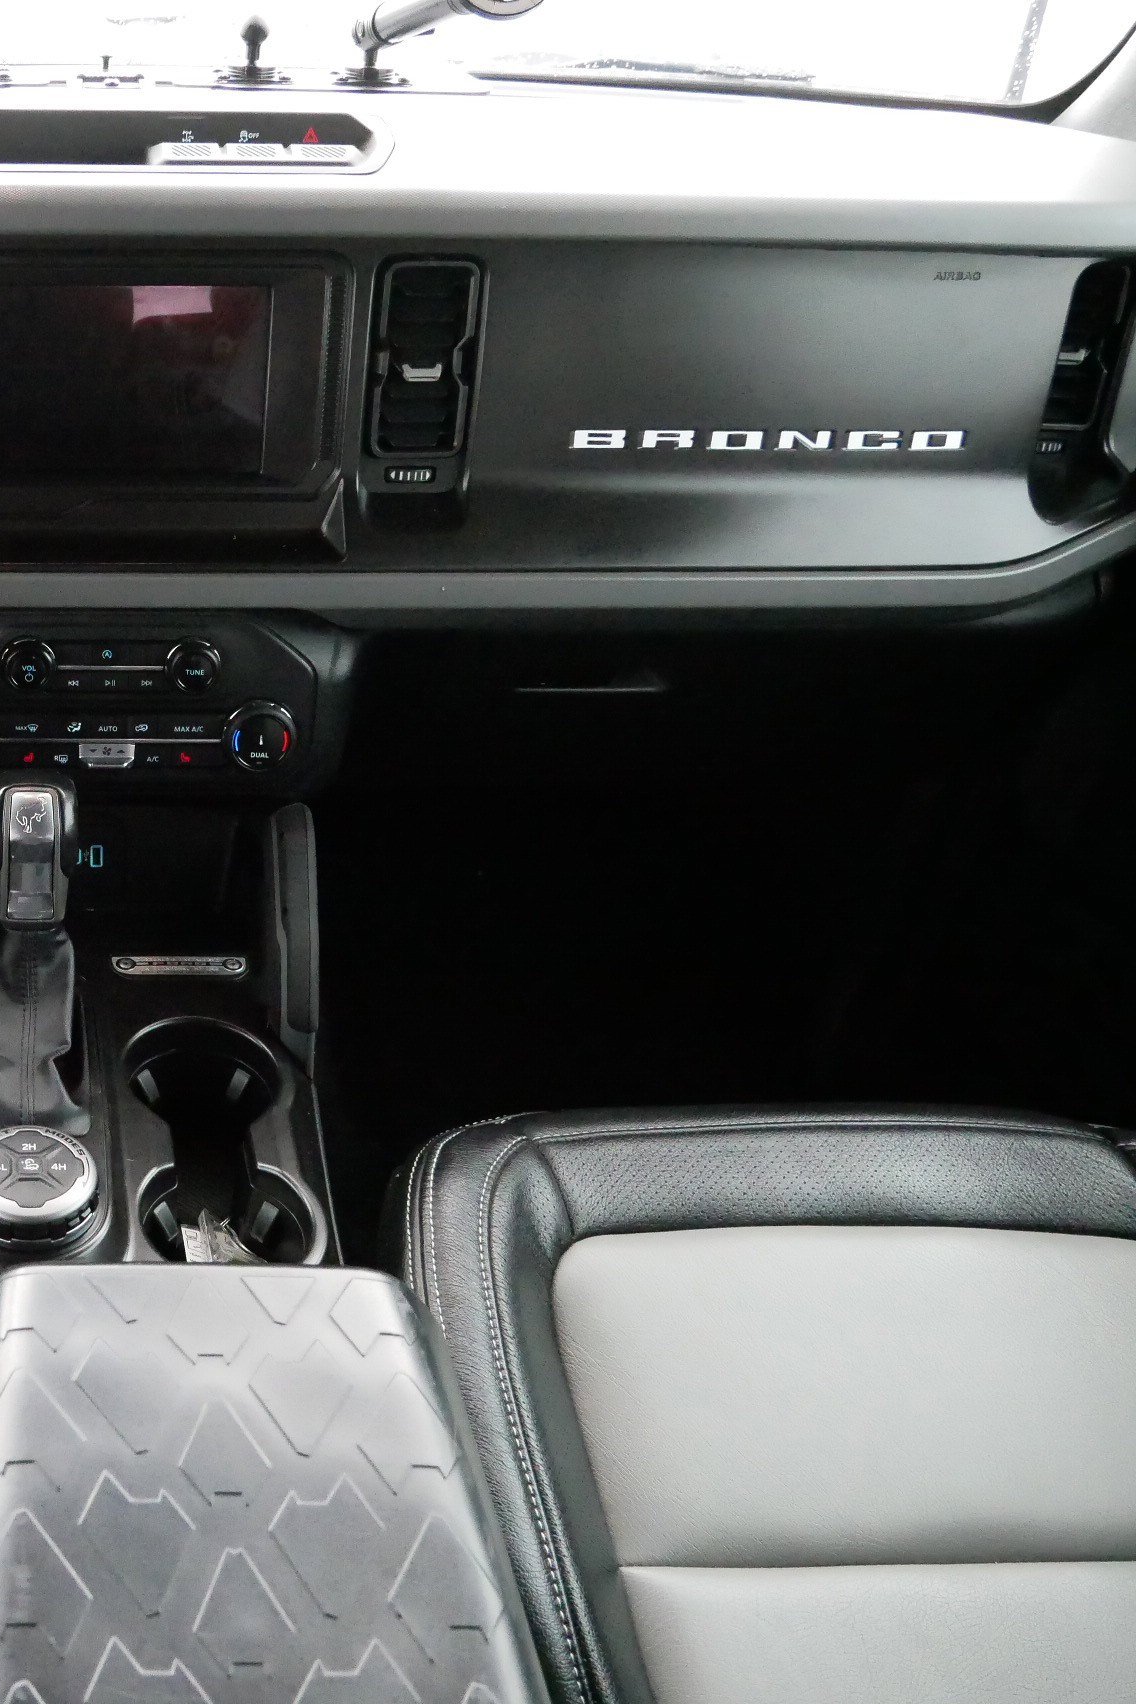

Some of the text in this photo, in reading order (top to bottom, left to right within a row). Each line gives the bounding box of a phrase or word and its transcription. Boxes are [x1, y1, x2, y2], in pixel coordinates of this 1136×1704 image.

[569, 429, 966, 451] BRONCO
[21, 1143, 37, 1151] 2H
[44, 1128, 86, 1157] MODES
[51, 1163, 67, 1171] 4H
